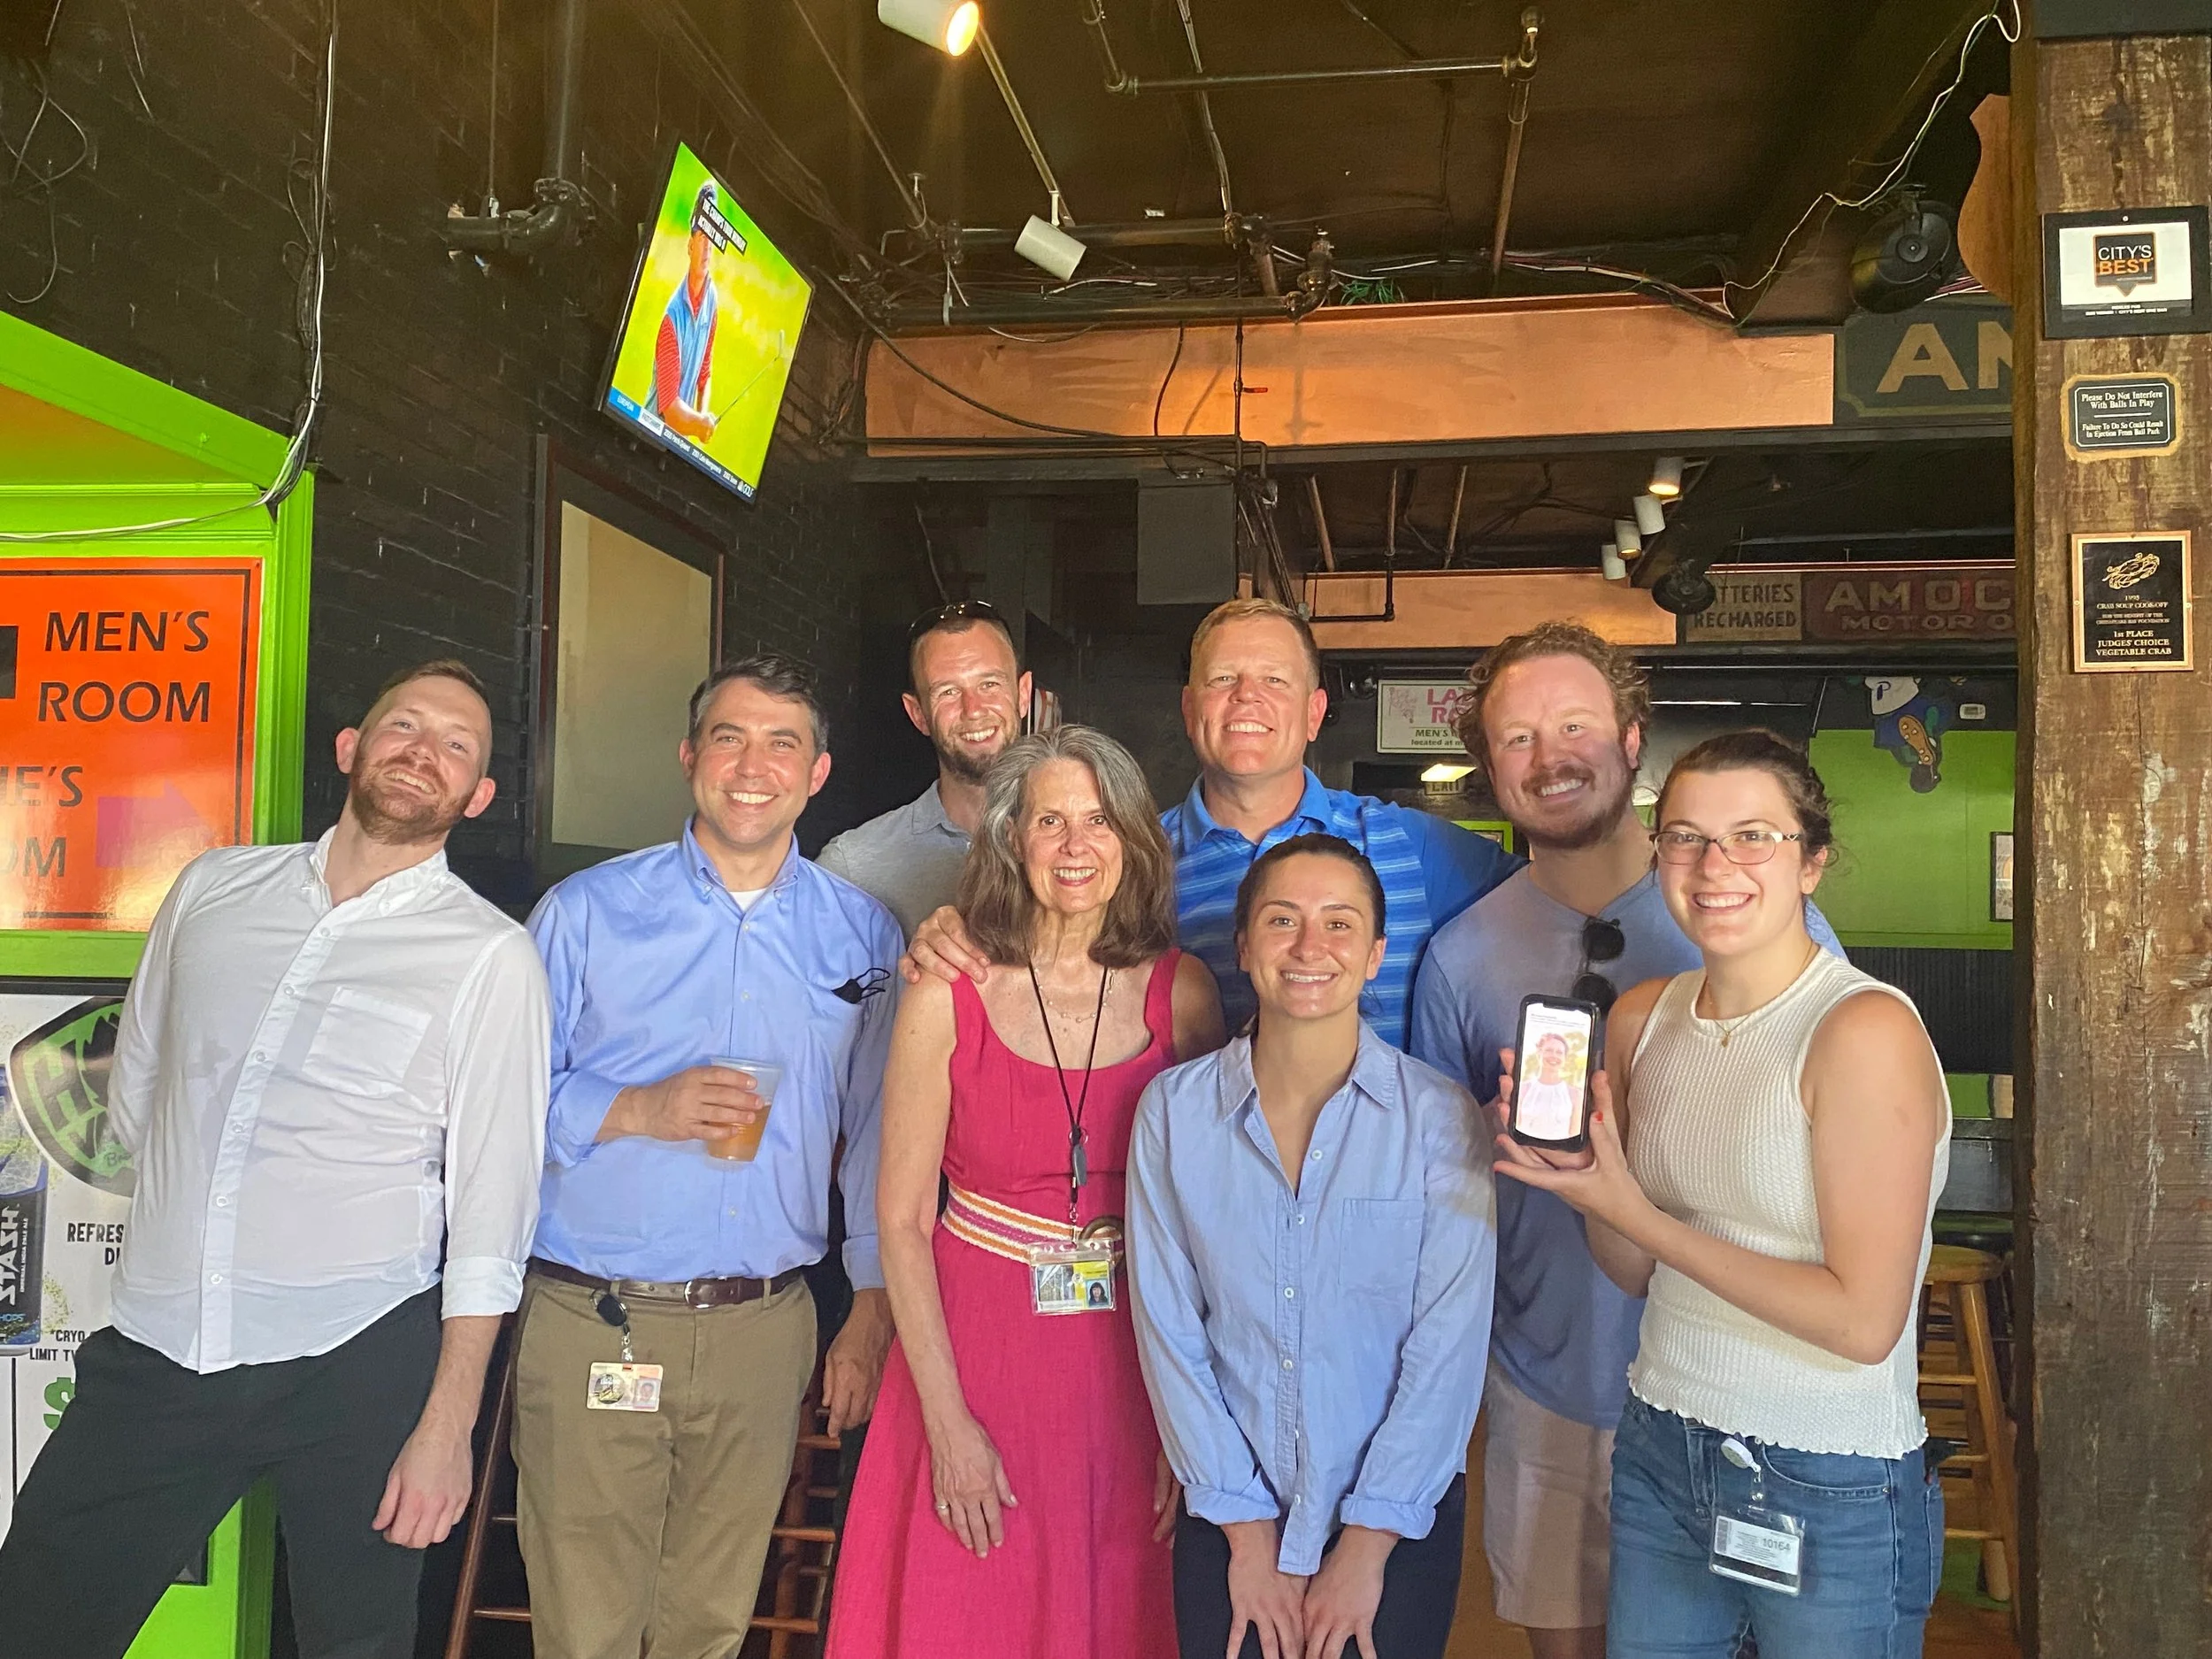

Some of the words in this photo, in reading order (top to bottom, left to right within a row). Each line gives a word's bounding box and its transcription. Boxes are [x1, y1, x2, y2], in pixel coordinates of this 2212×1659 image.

[2098, 244, 2152, 260] CITY'S
[2099, 257, 2152, 276] BEST
[2081, 394, 2103, 403] Please
[2139, 399, 2154, 408] Play
[1714, 584, 1794, 604] TTERIES
[1694, 610, 1796, 628] RECHARGED
[1841, 614, 1975, 631] MOTOR
[45, 611, 210, 651] MEN'S
[37, 681, 210, 722] ROOM
[67, 1223, 125, 1243] REFRES
[29, 1348, 58, 1361] LIMIT
